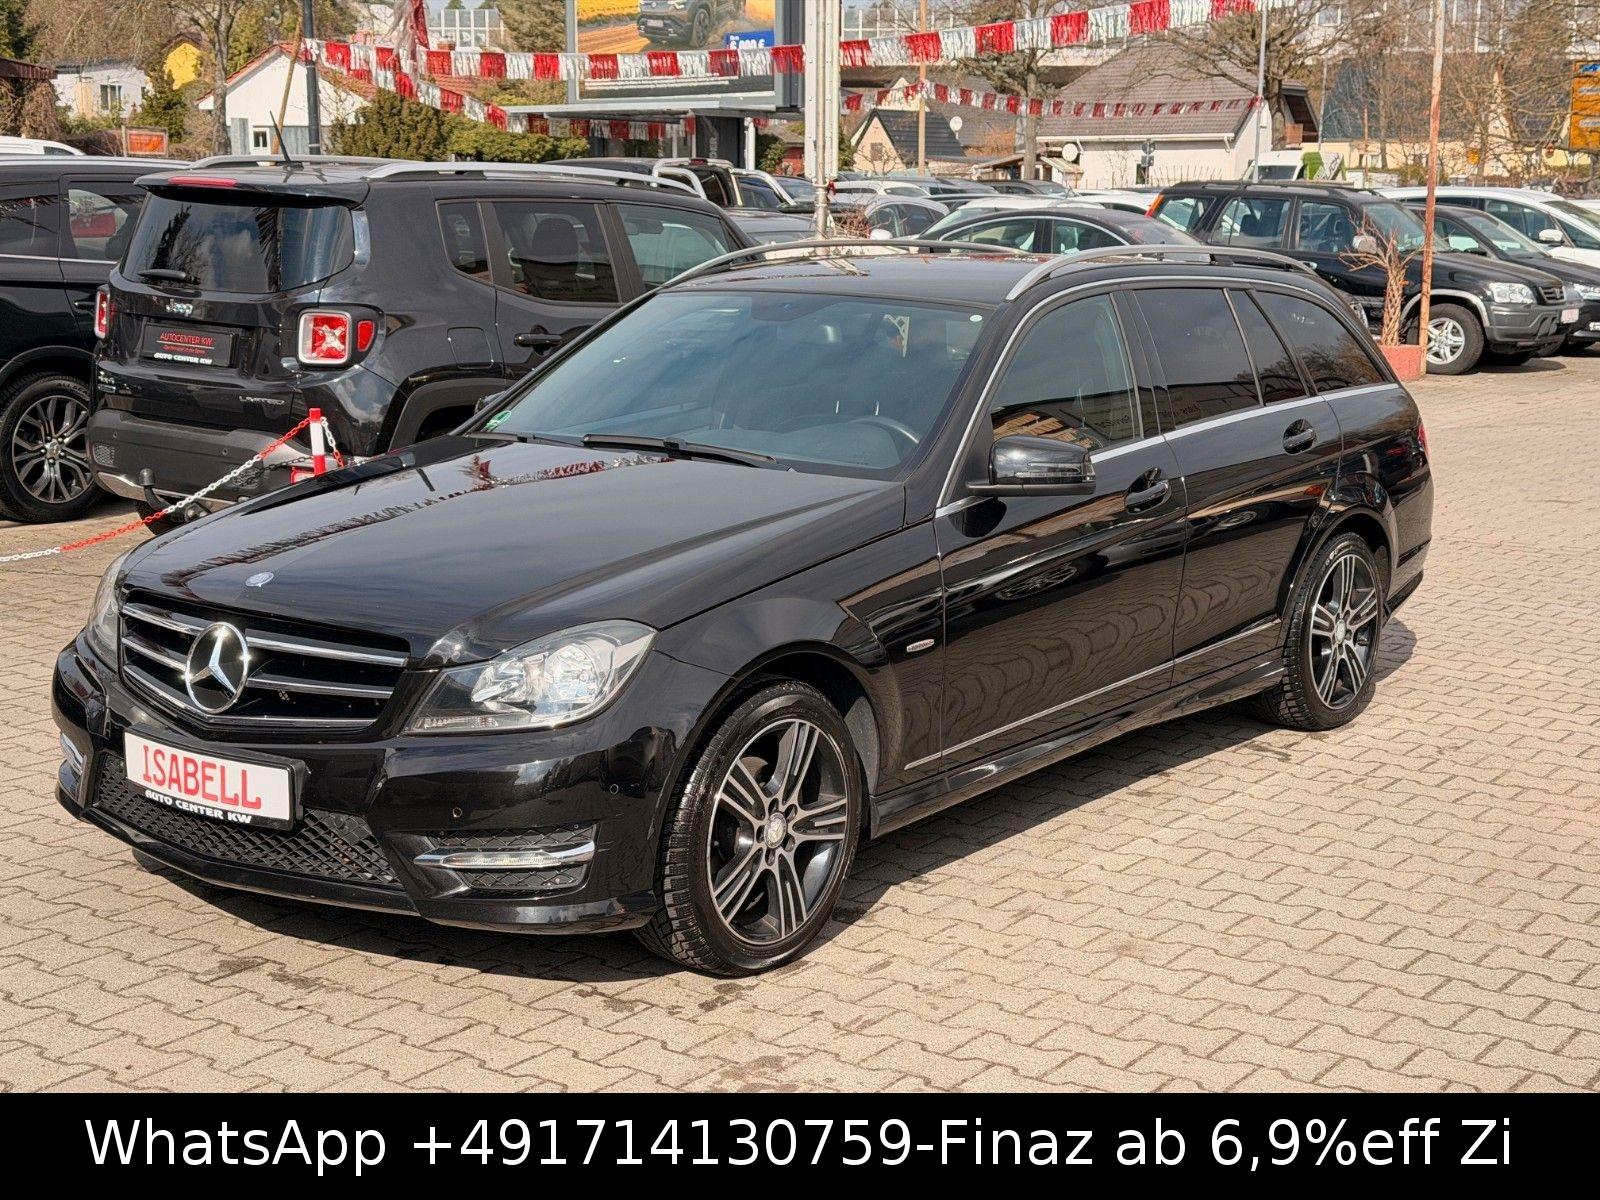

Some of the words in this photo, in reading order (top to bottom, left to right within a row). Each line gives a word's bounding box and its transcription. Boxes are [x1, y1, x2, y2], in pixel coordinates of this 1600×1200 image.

[166, 299, 193, 317] Jeep
[161, 333, 200, 344] AUTOCENTER
[201, 336, 212, 345] KW
[174, 355, 199, 363] CENTER
[142, 744, 262, 810] ISABELL
[145, 790, 172, 806] AUTO
[175, 798, 224, 820] CENTER
[227, 812, 252, 824] KW
